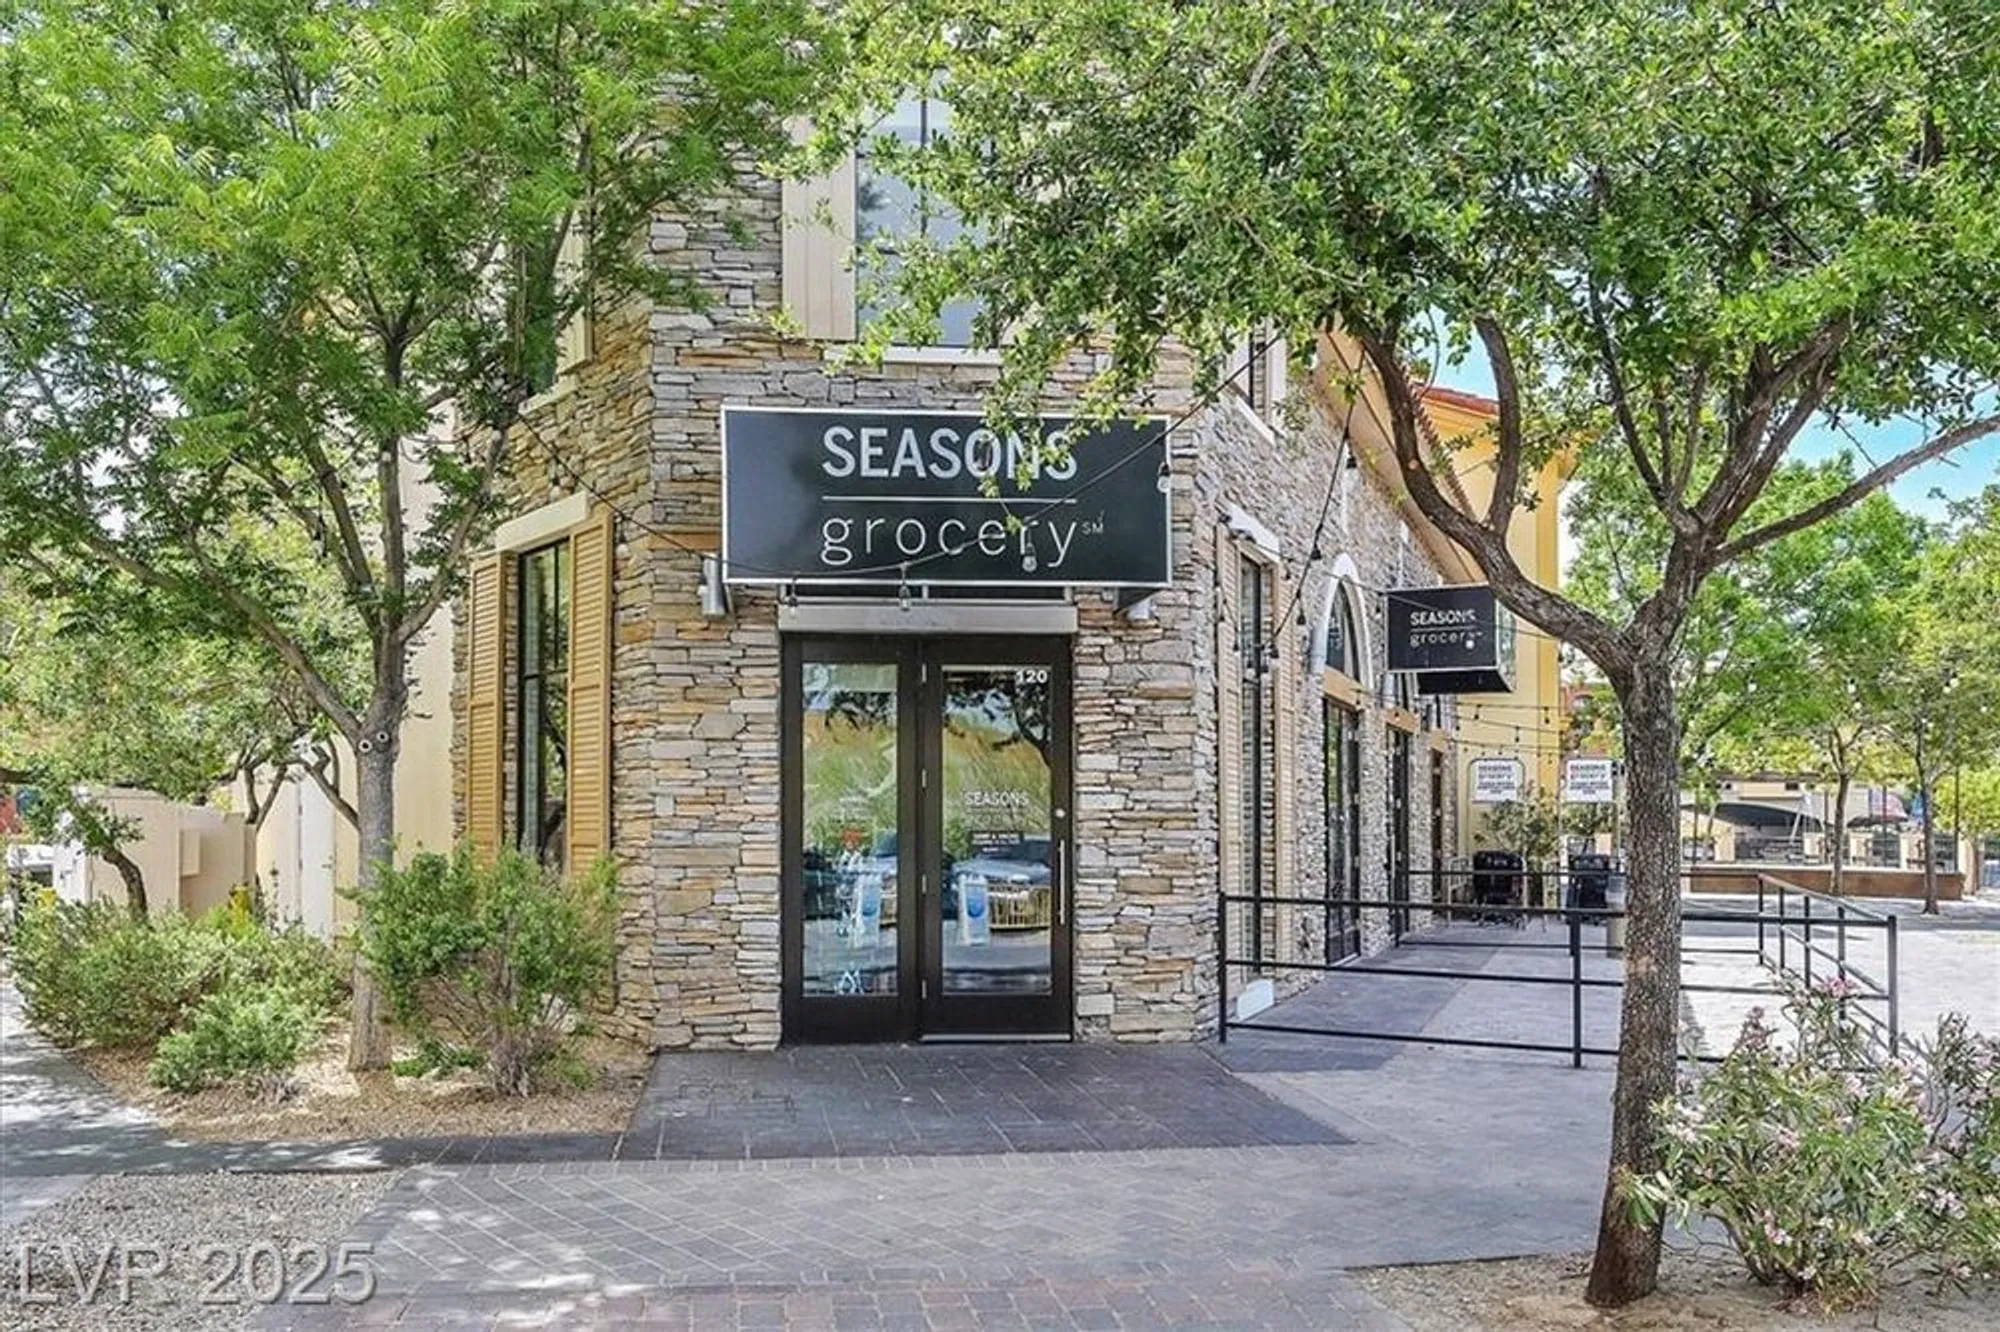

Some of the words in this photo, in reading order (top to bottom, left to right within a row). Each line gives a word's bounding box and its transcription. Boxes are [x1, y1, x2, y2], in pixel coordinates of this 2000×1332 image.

[822, 426, 1077, 480] SEASONS
[819, 516, 1077, 567] grocery
[1409, 609, 1476, 626] SEASONS
[1015, 669, 1048, 684] 120
[964, 791, 1030, 806] SEASONS
